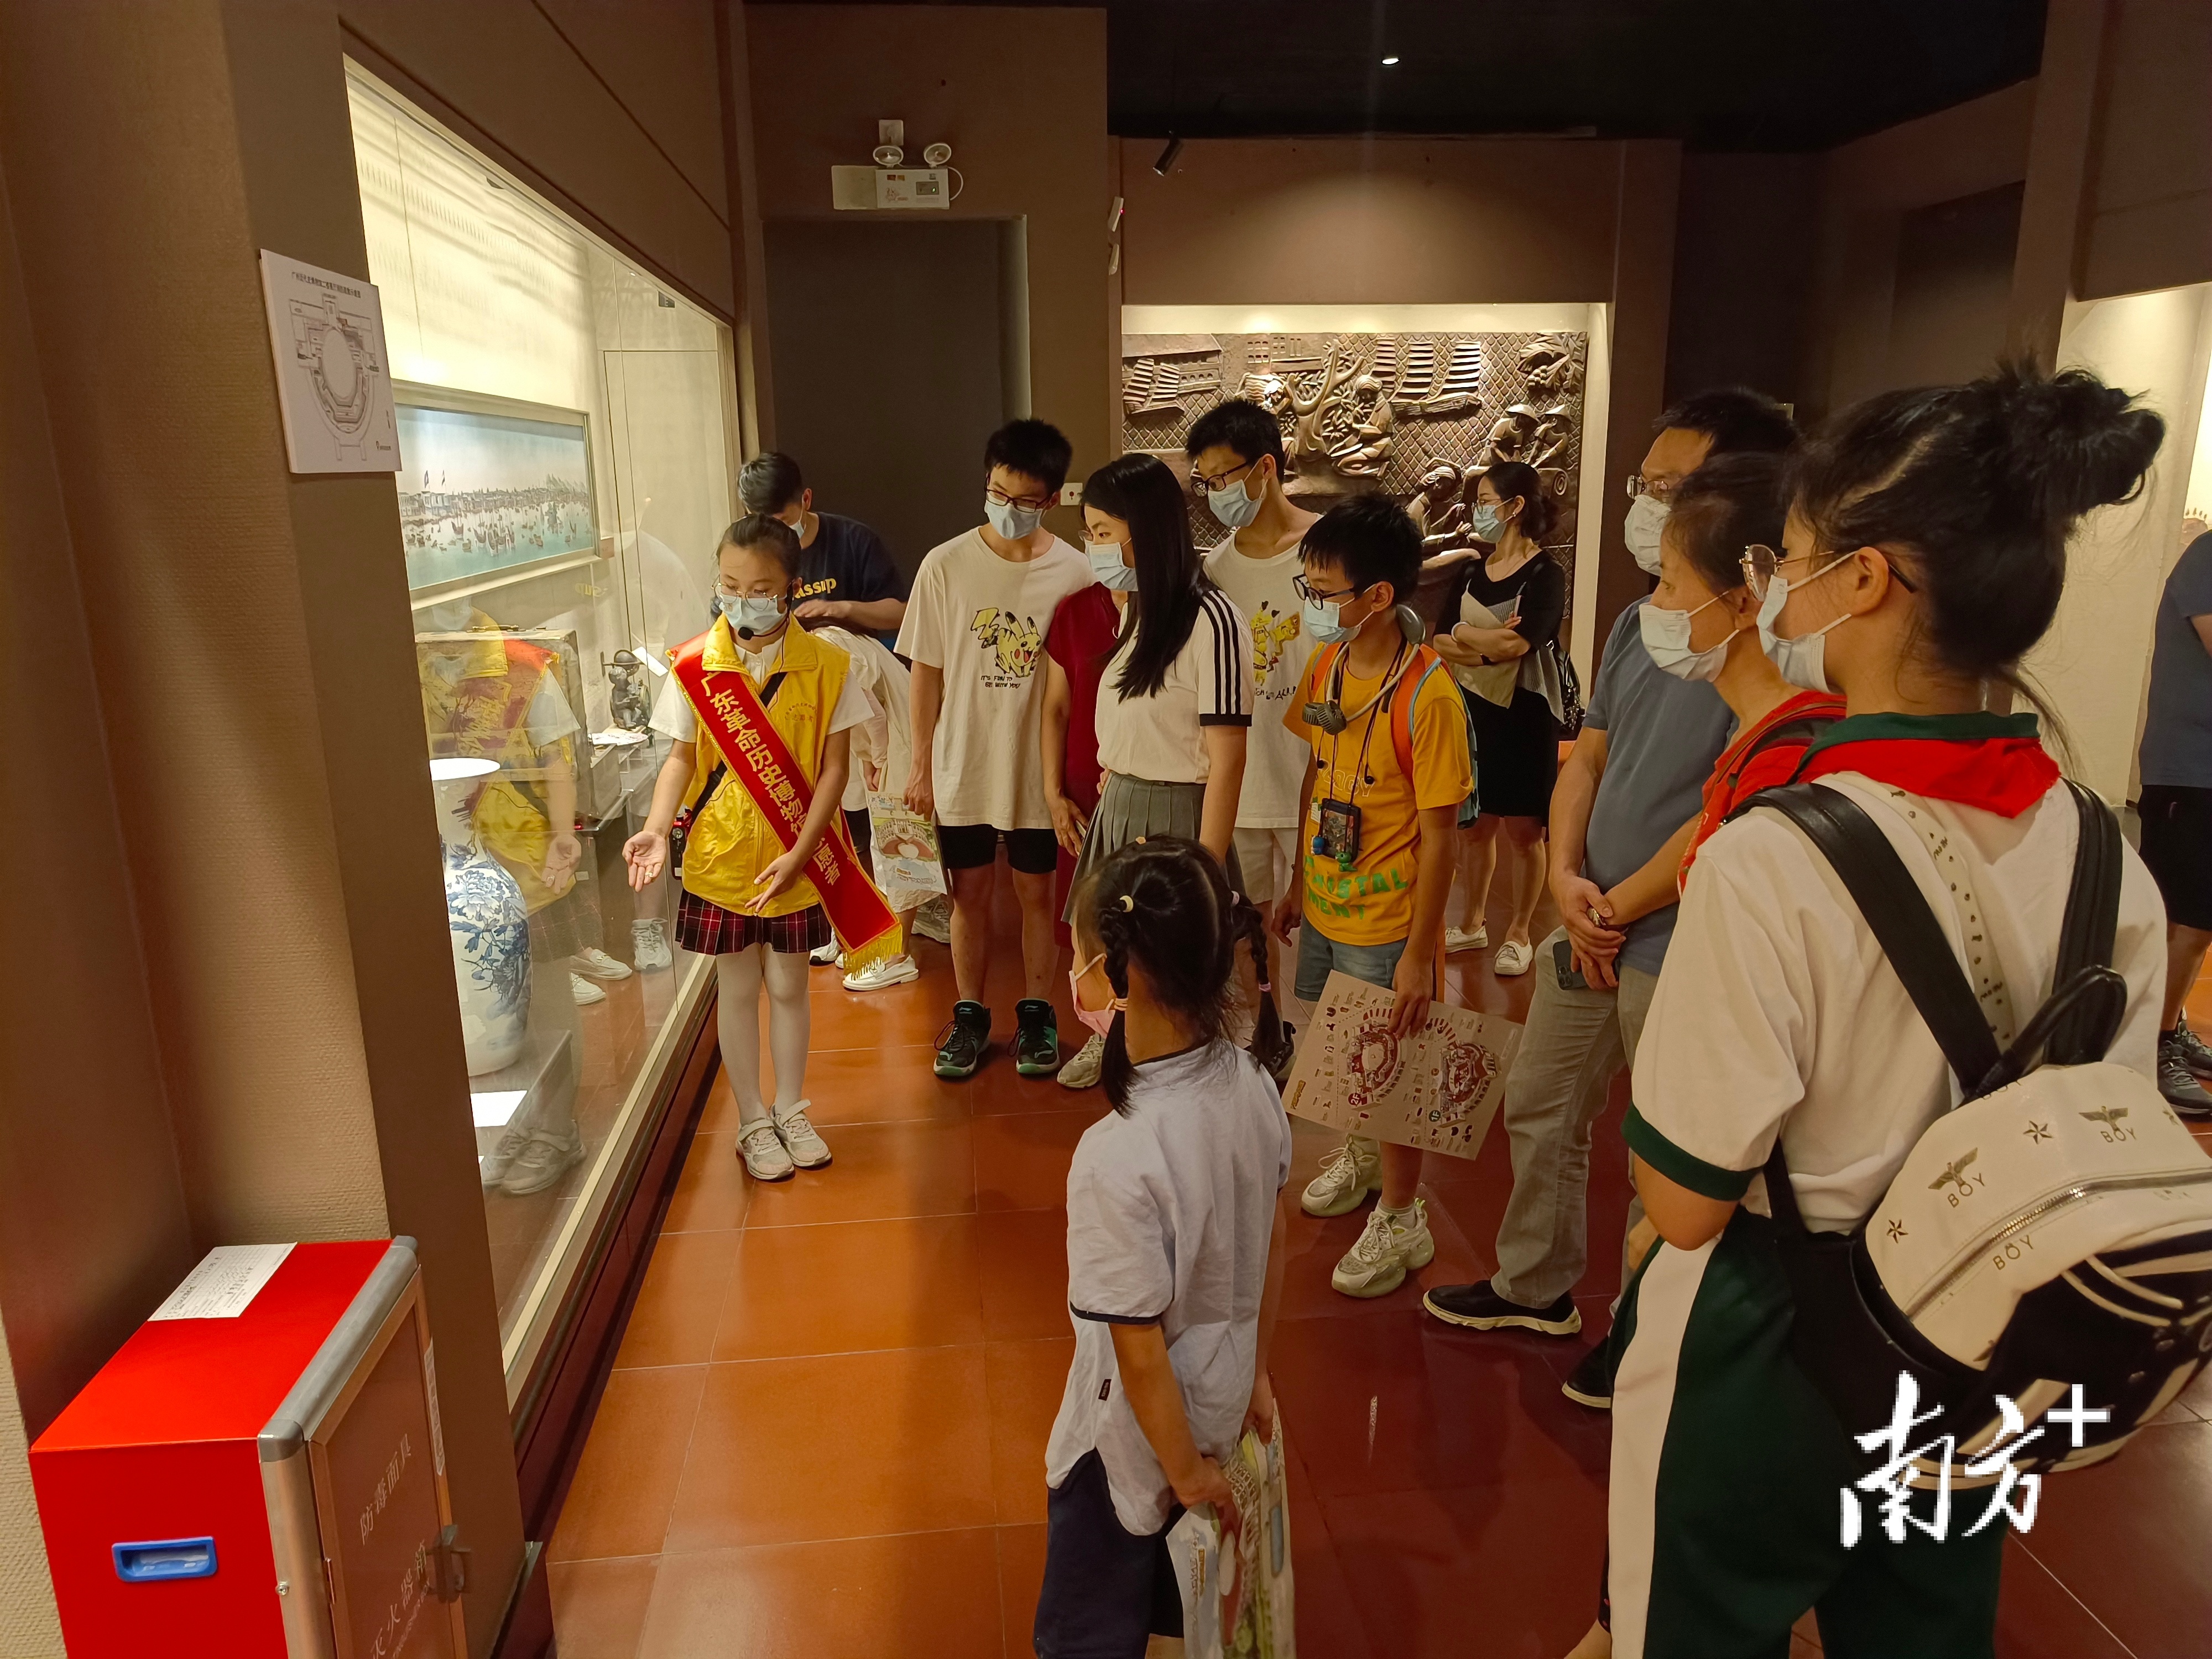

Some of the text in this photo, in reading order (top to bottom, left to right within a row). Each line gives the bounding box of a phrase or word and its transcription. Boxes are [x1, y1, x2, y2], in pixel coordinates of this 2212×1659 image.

[701, 671, 841, 886] 广东革命历史博物馆愿者
[1350, 1093, 1359, 1105] 2F
[1431, 1110, 1440, 1121] 1F
[2100, 1127, 2137, 1143] BOY
[1947, 1172, 1985, 1208] BOY
[1992, 1234, 2034, 1271] BOY
[360, 1433, 411, 1547] 防毒面具
